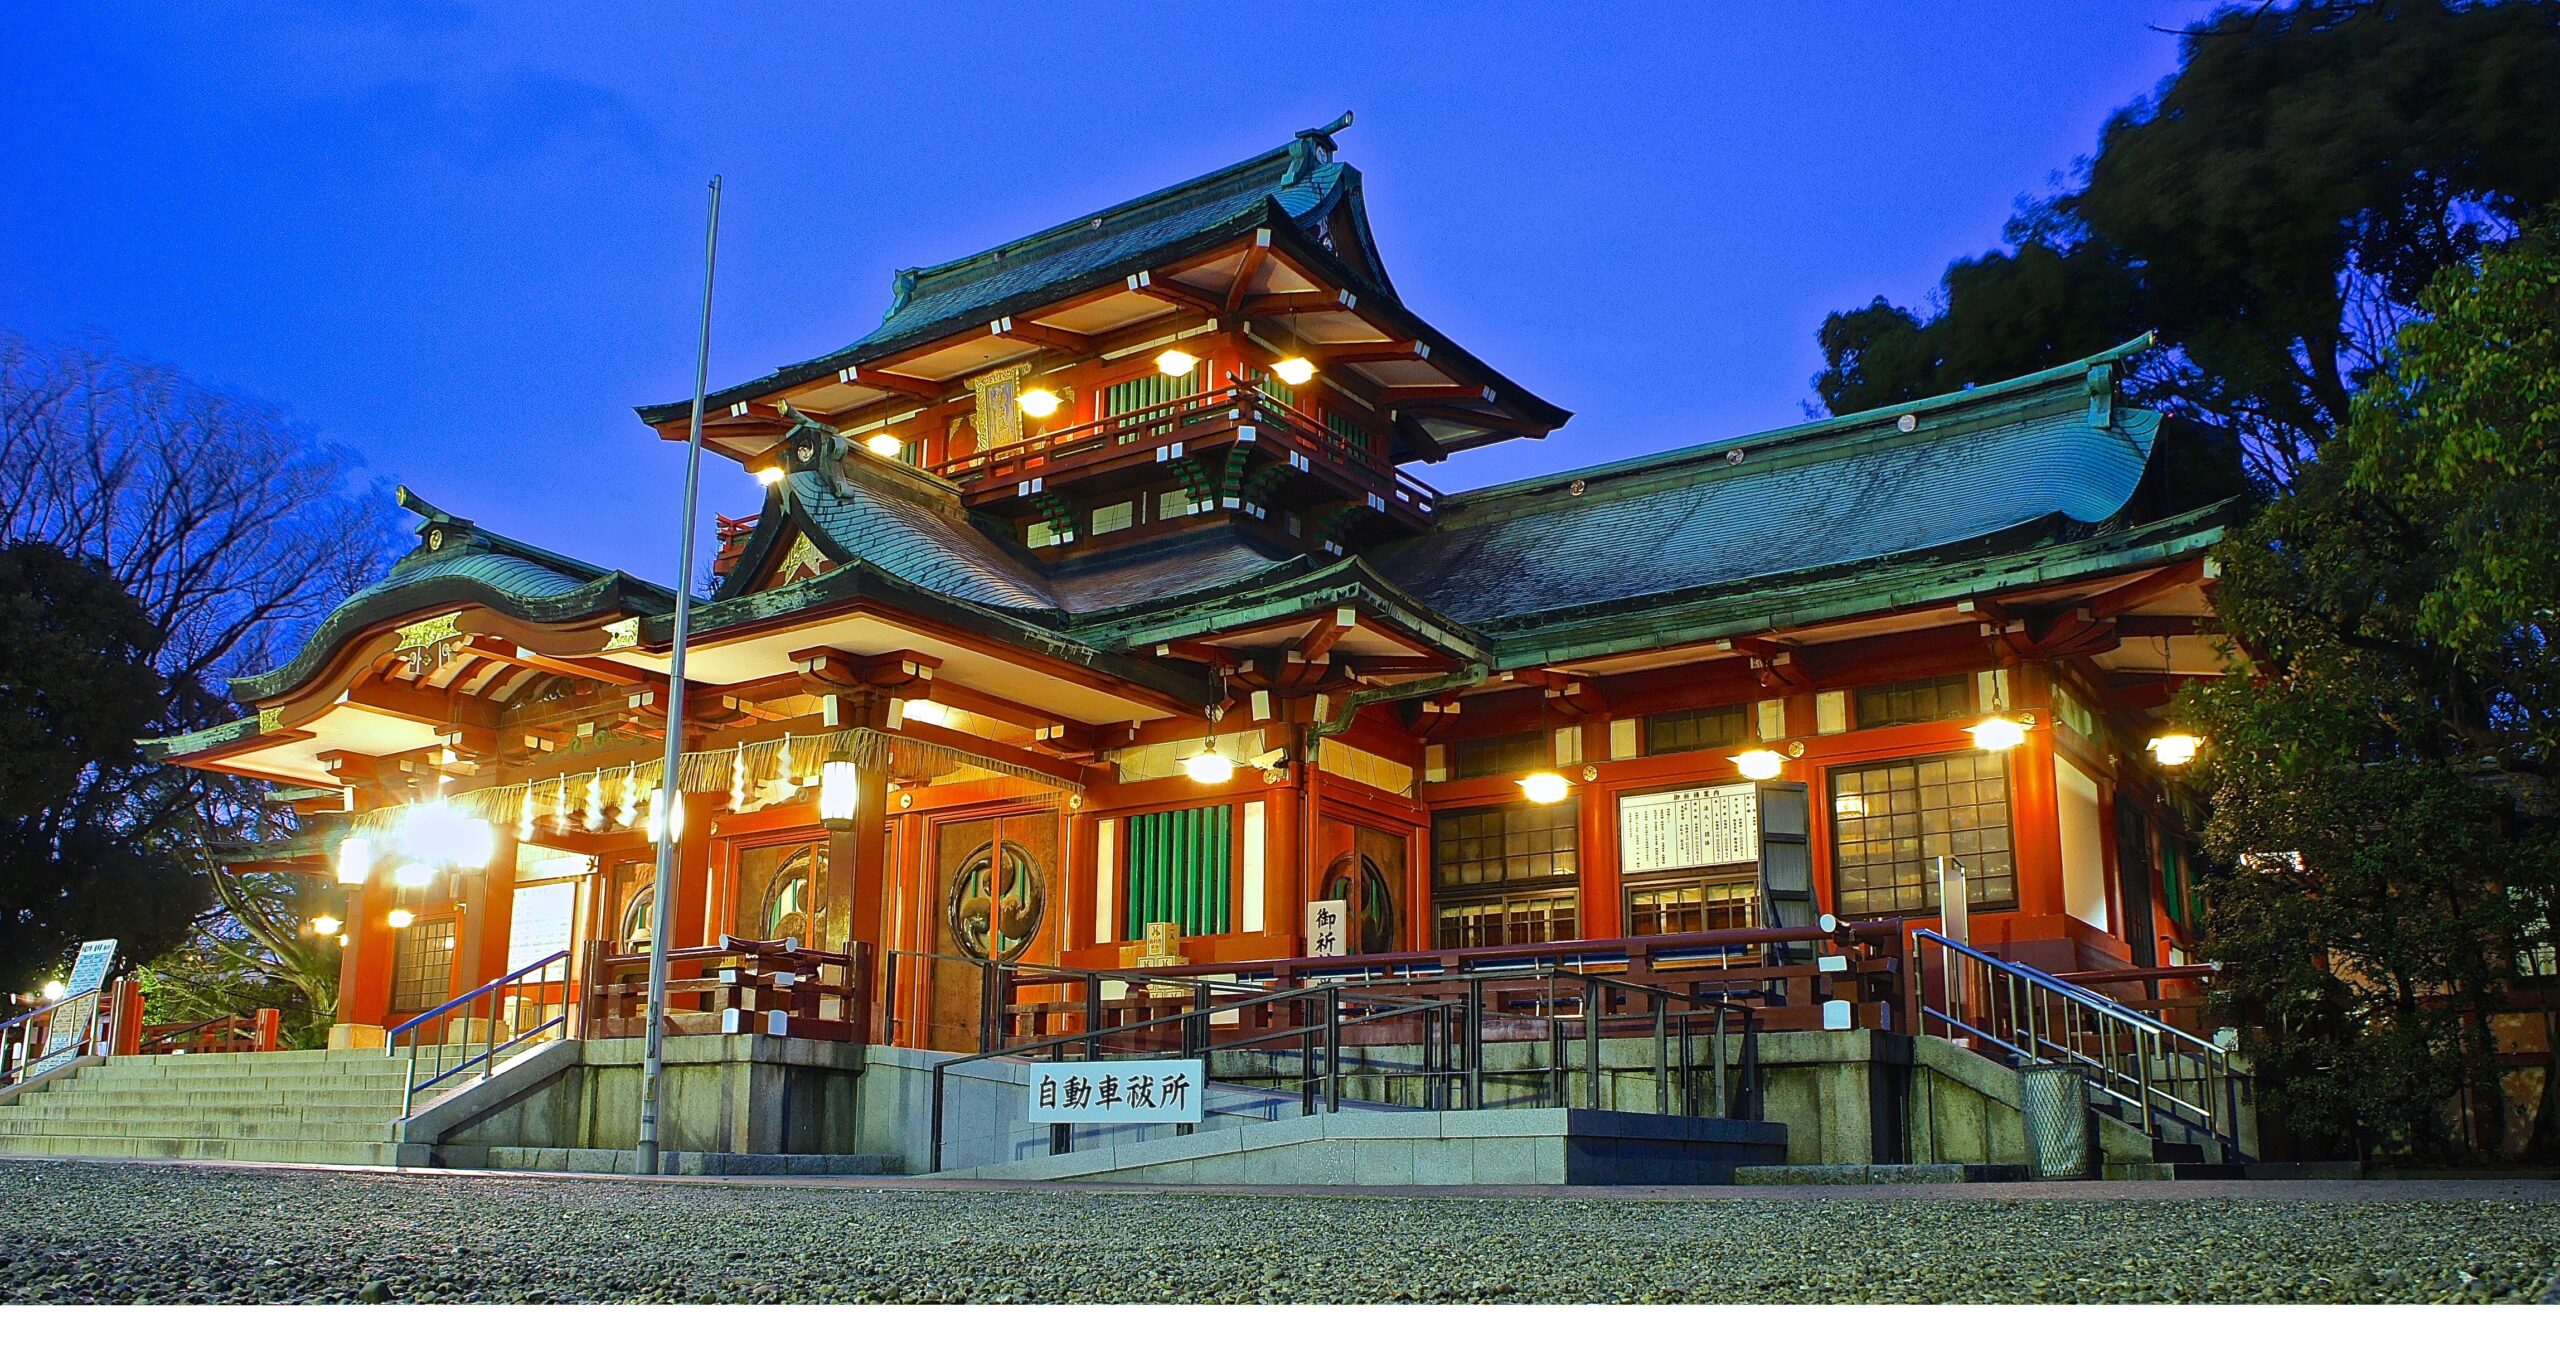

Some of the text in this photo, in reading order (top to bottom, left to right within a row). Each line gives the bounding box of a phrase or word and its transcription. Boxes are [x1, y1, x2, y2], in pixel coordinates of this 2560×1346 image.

[1315, 908, 1336, 957] 御祈
[1039, 1073, 1190, 1111] 自動車祓所
